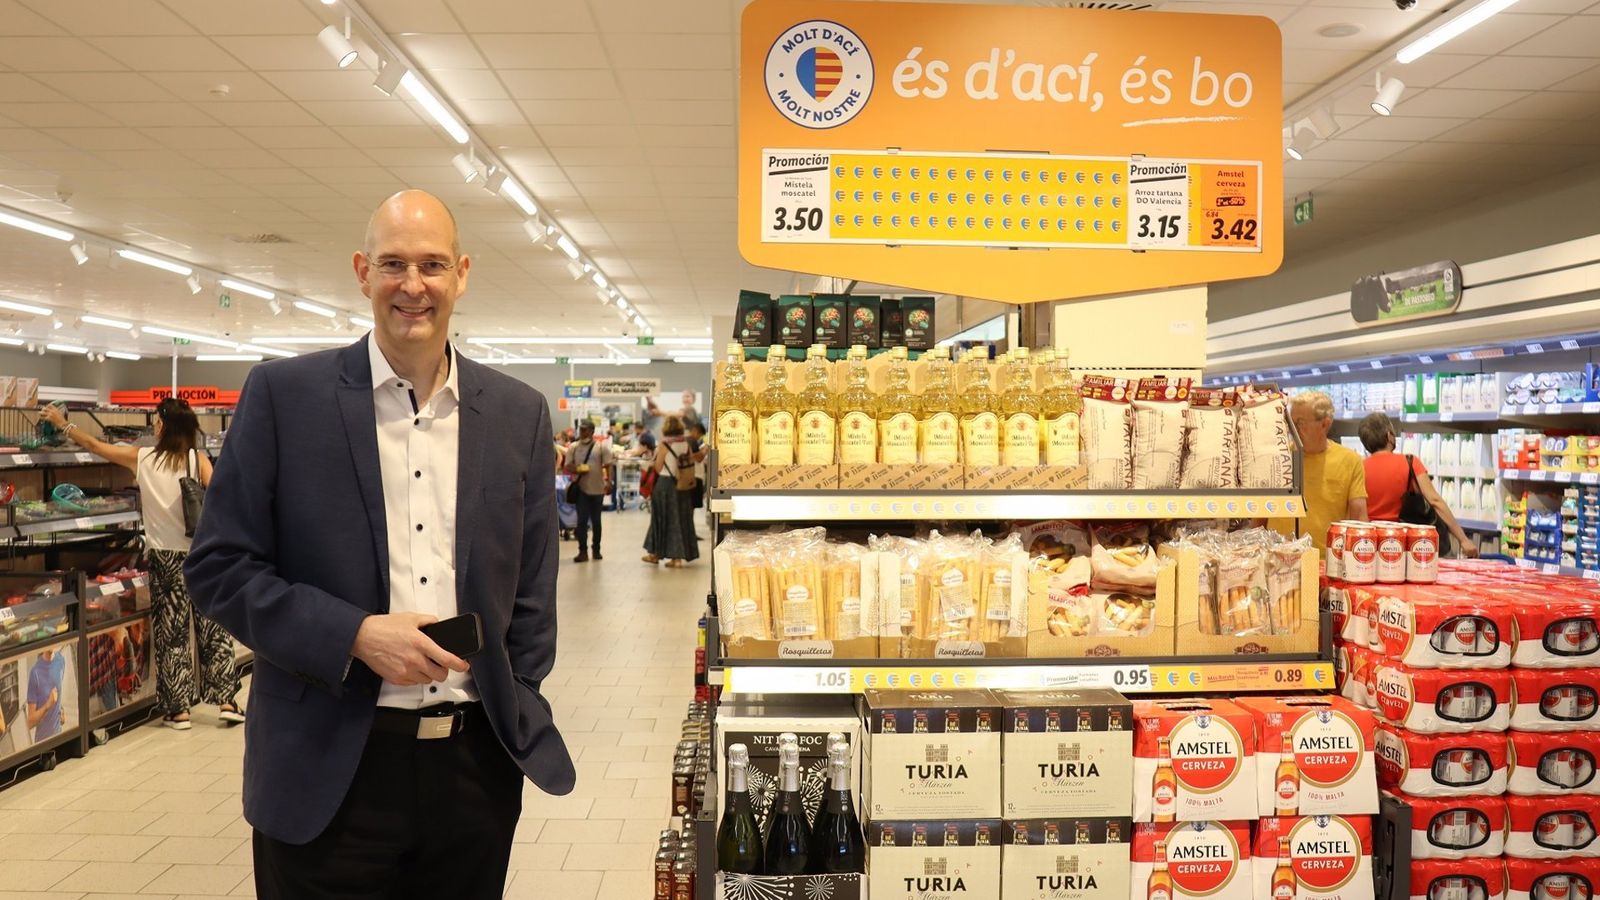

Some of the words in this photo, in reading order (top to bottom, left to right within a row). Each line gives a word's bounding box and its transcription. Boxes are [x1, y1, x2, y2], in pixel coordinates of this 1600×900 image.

[782, 28, 818, 53] MOLT
[822, 28, 860, 56] D'ACÍ
[892, 47, 950, 98] és
[964, 47, 1104, 113] d'ací,
[1120, 56, 1173, 105] és
[1189, 56, 1253, 108] bo
[778, 89, 811, 119] MOLT
[813, 88, 861, 122] NOSTRE
[769, 153, 829, 168] Promoción
[1130, 162, 1187, 176] Promoción
[1217, 170, 1244, 178] Amstel
[784, 181, 813, 189] Mistela
[1150, 197, 1182, 205] Valencia
[773, 207, 823, 231] 3.50
[1137, 214, 1182, 238] 3.15
[1211, 218, 1257, 240] 3.42
[1087, 377, 1114, 386] FAMILIAR
[1141, 378, 1167, 386] FAMILIAR
[153, 389, 216, 400] PROMOCIÓN
[1219, 420, 1234, 488] TARTANA
[1275, 420, 1293, 487] TARTANA
[1328, 600, 1345, 612] STEL
[1380, 608, 1407, 629] AMSTEL
[1382, 627, 1404, 641] CERVEZA
[782, 646, 832, 657] Rosquilletas
[938, 647, 984, 657] Rosquilletas
[815, 672, 846, 687] 1.05
[1113, 669, 1148, 686] 0.95
[1274, 669, 1303, 682] 0.89
[1378, 679, 1407, 699] AMSTEL
[1380, 695, 1404, 709] CERVEZA
[753, 735, 774, 745] NIT
[800, 735, 822, 745] FOC
[1299, 736, 1353, 749] AMSTEL
[1176, 742, 1232, 755] AMSTEL
[1375, 740, 1402, 765] AMSTEL
[1182, 761, 1226, 770] CERVEZA
[1304, 755, 1348, 765] CERVEZA
[905, 765, 968, 779] TURIA
[1038, 763, 1100, 778] TURIA
[1186, 798, 1201, 806] 100%
[1203, 797, 1224, 806] MALTA
[1307, 792, 1323, 800] 100%
[1325, 791, 1345, 801] MALTA
[1173, 845, 1228, 859] AMSTEL
[1296, 841, 1351, 855] AMSTEL
[1177, 864, 1222, 873] CERVEZA
[1301, 860, 1345, 869] CERVEZA
[904, 877, 967, 892] TURIA
[1036, 875, 1098, 890] TURIA
